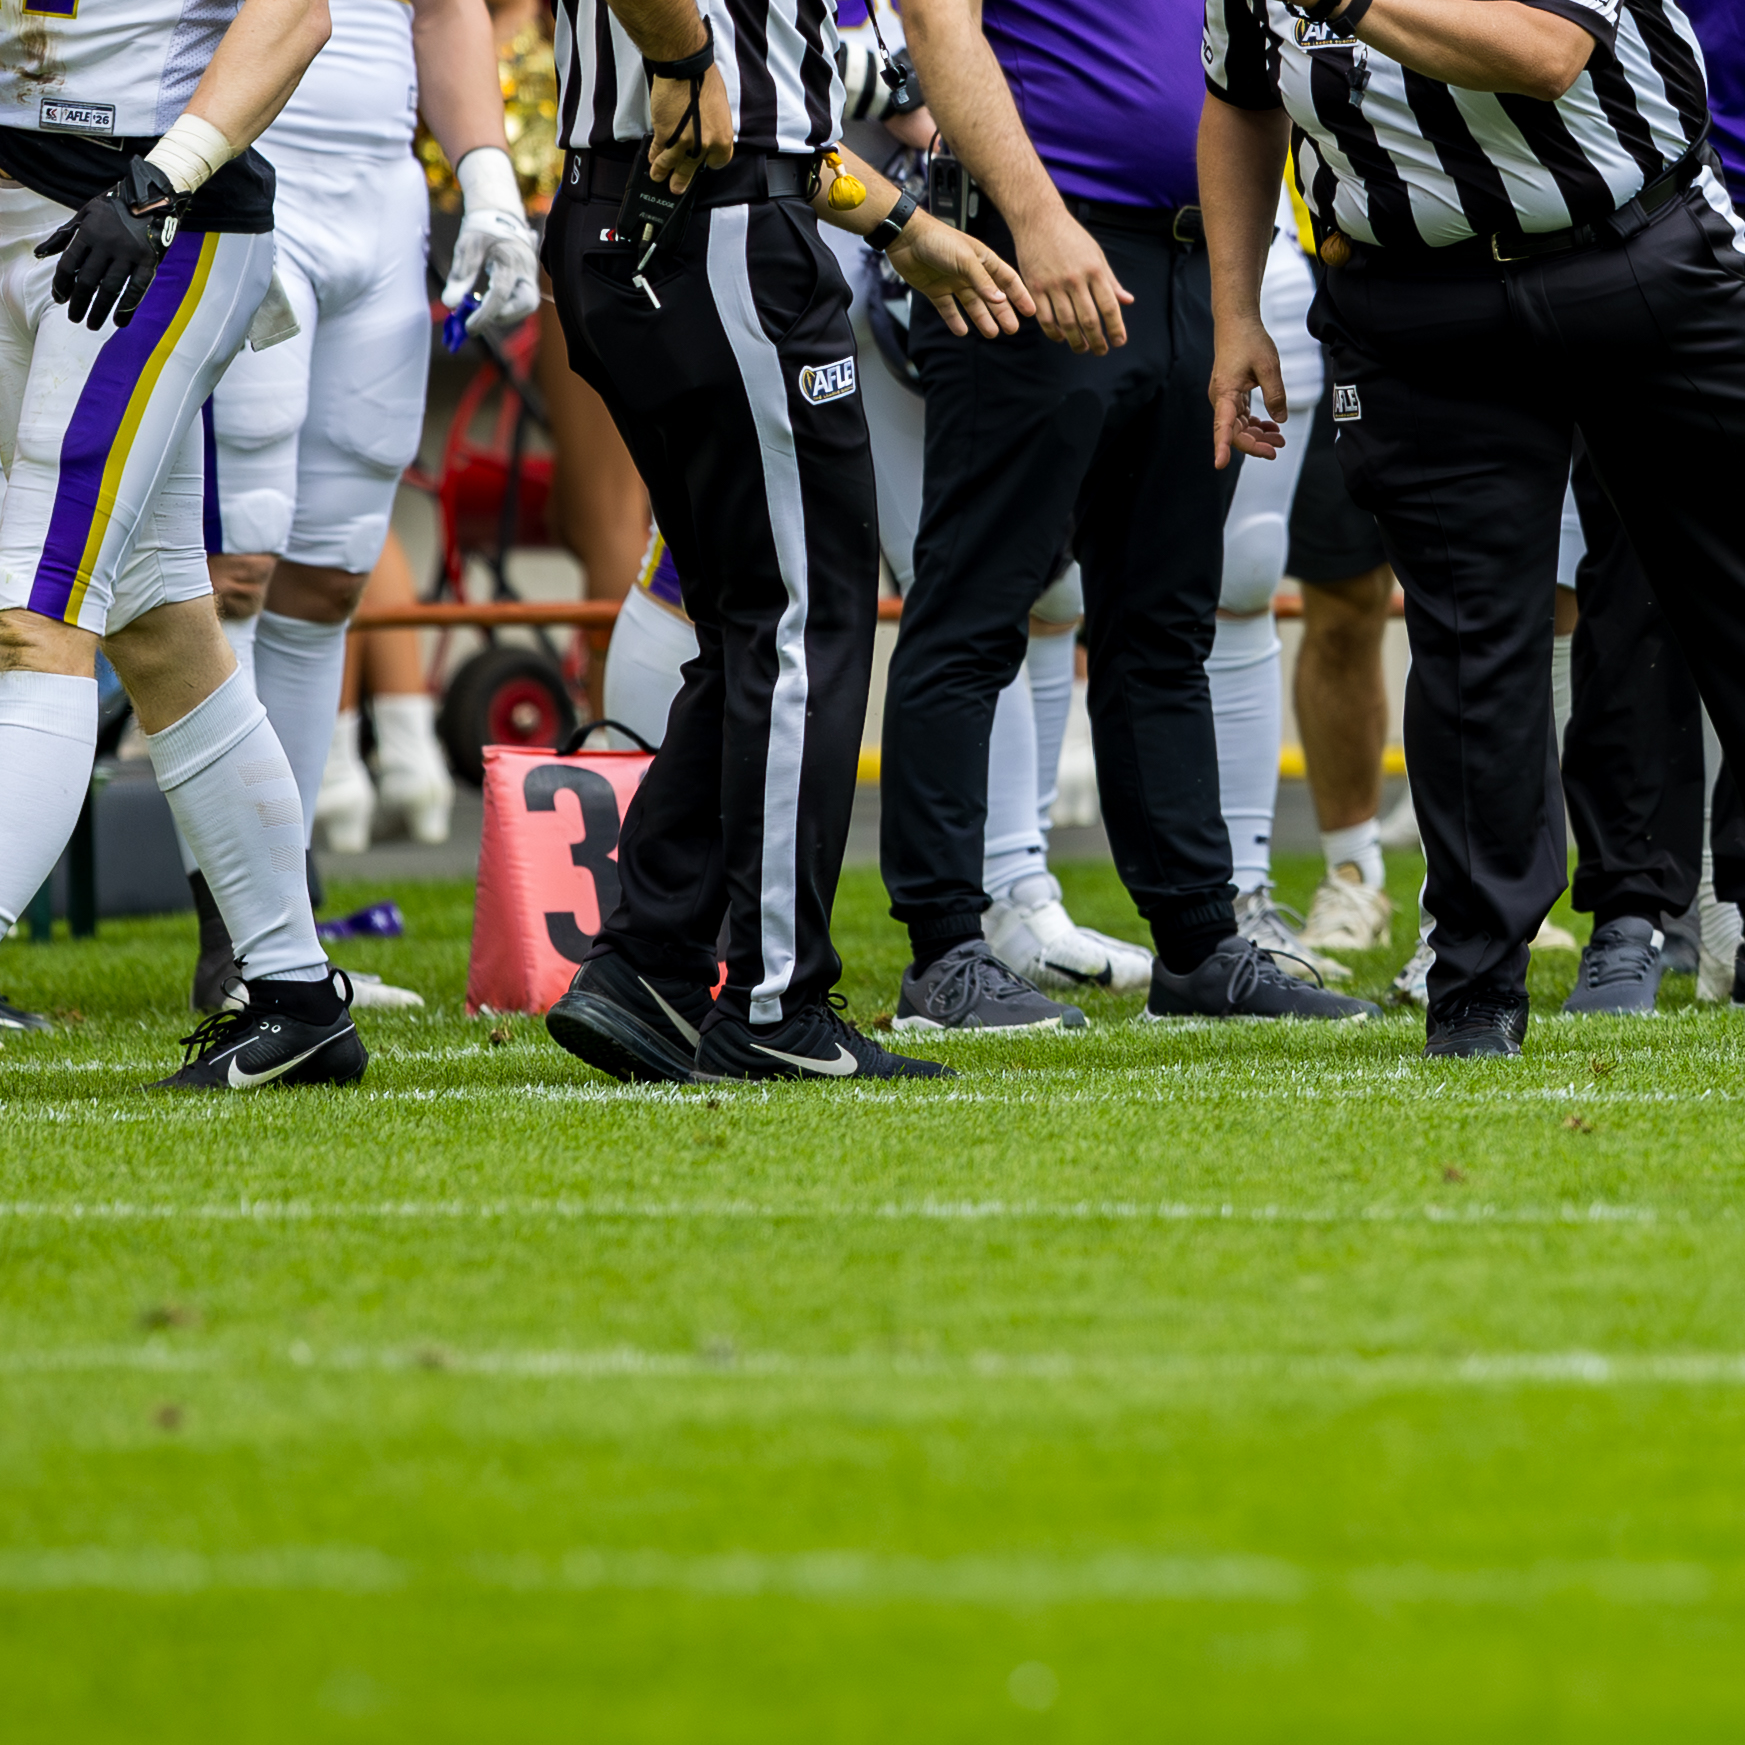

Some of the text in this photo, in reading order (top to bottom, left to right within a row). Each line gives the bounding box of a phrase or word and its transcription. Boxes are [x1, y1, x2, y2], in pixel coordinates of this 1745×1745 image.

[65, 110, 91, 124] AFLE
[93, 114, 110, 125] '26
[813, 361, 853, 397] AFLE
[523, 764, 648, 965] 3
